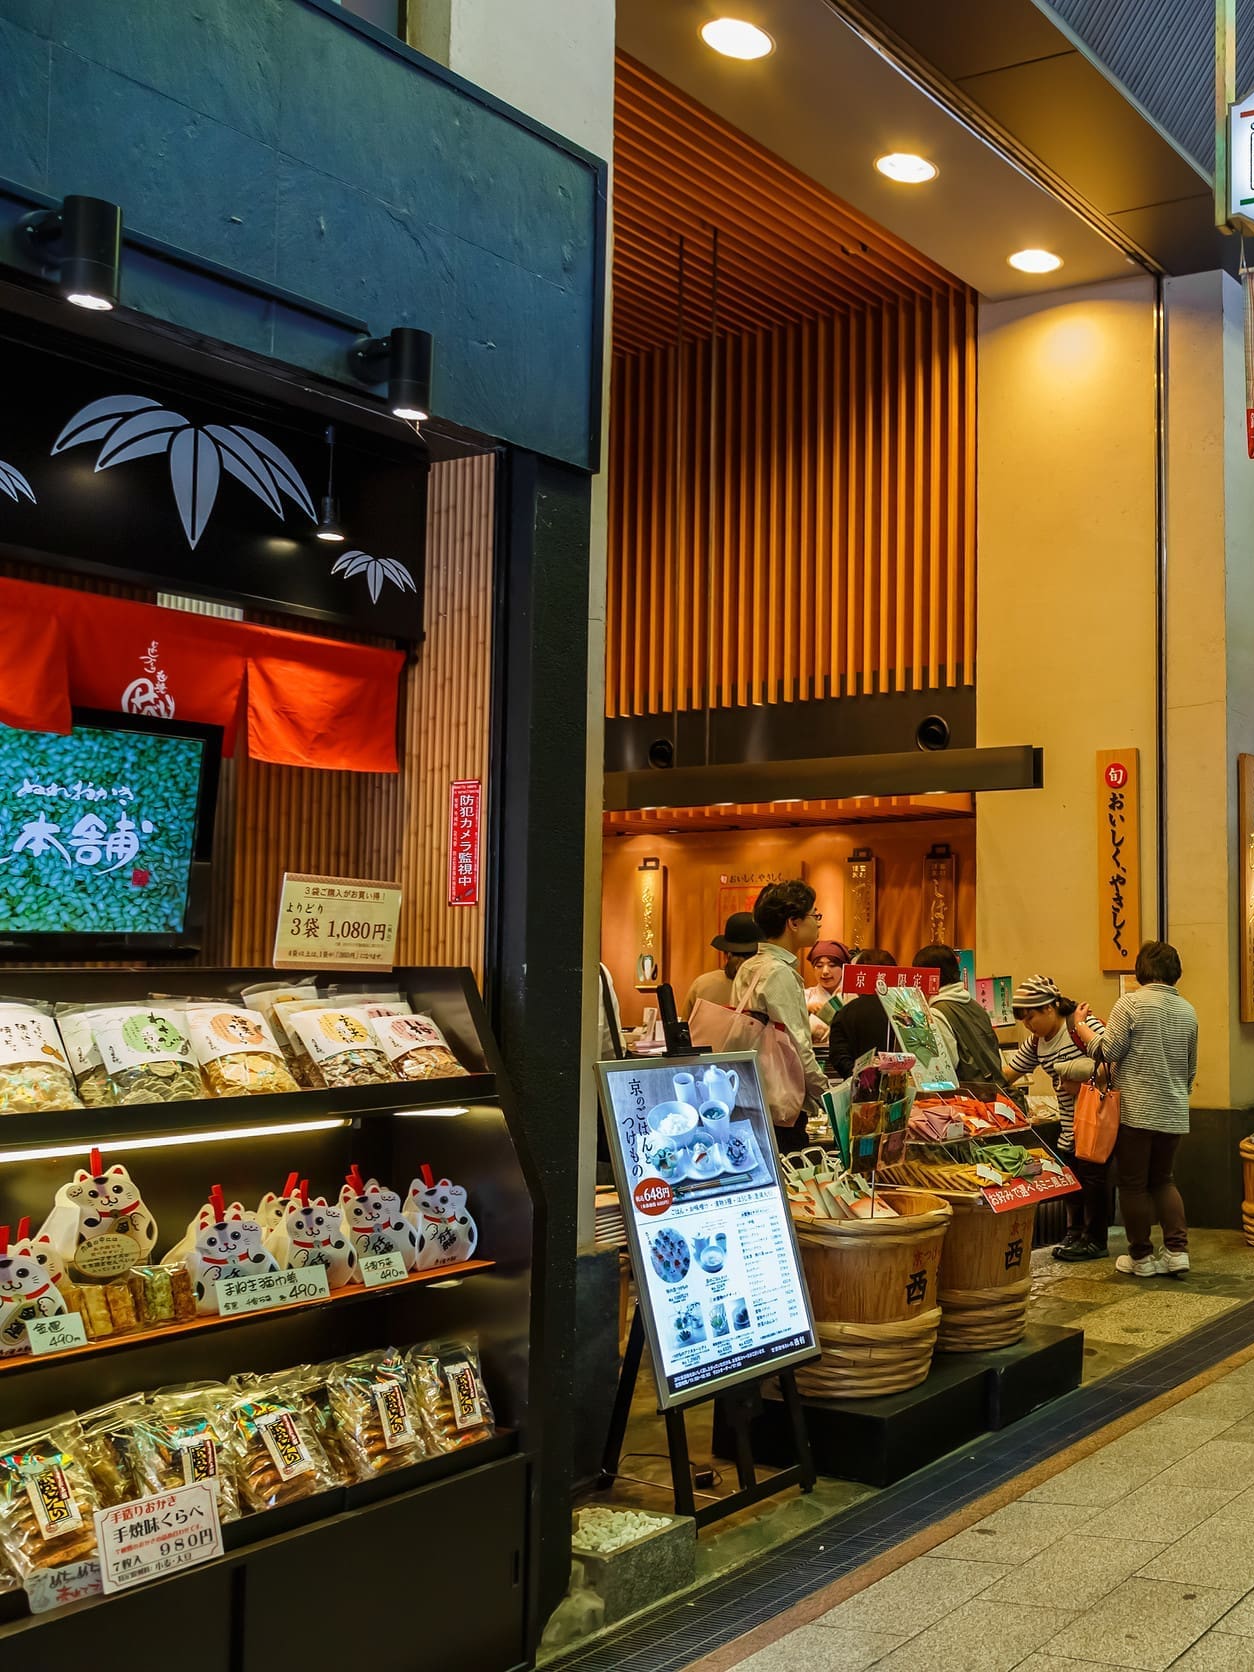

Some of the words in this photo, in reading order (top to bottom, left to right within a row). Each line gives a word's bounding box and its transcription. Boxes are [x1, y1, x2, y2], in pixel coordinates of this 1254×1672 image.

[1108, 768, 1124, 784] 旬
[458, 794, 475, 887] 防犯カメラ監視中
[1108, 792, 1128, 957] おいしく、やさしく。
[286, 902, 323, 914] よりどり
[290, 917, 320, 939] 3袋
[327, 920, 387, 941] 1,080円
[628, 1078, 652, 1165] 京のごはんと
[622, 1115, 643, 1178] つけもの
[1004, 1238, 1024, 1271] 西
[905, 1269, 928, 1305] 西
[110, 1494, 178, 1524] 手造りおかき
[112, 1505, 205, 1544] 手焼味くらべ
[159, 1528, 214, 1557] 980円
